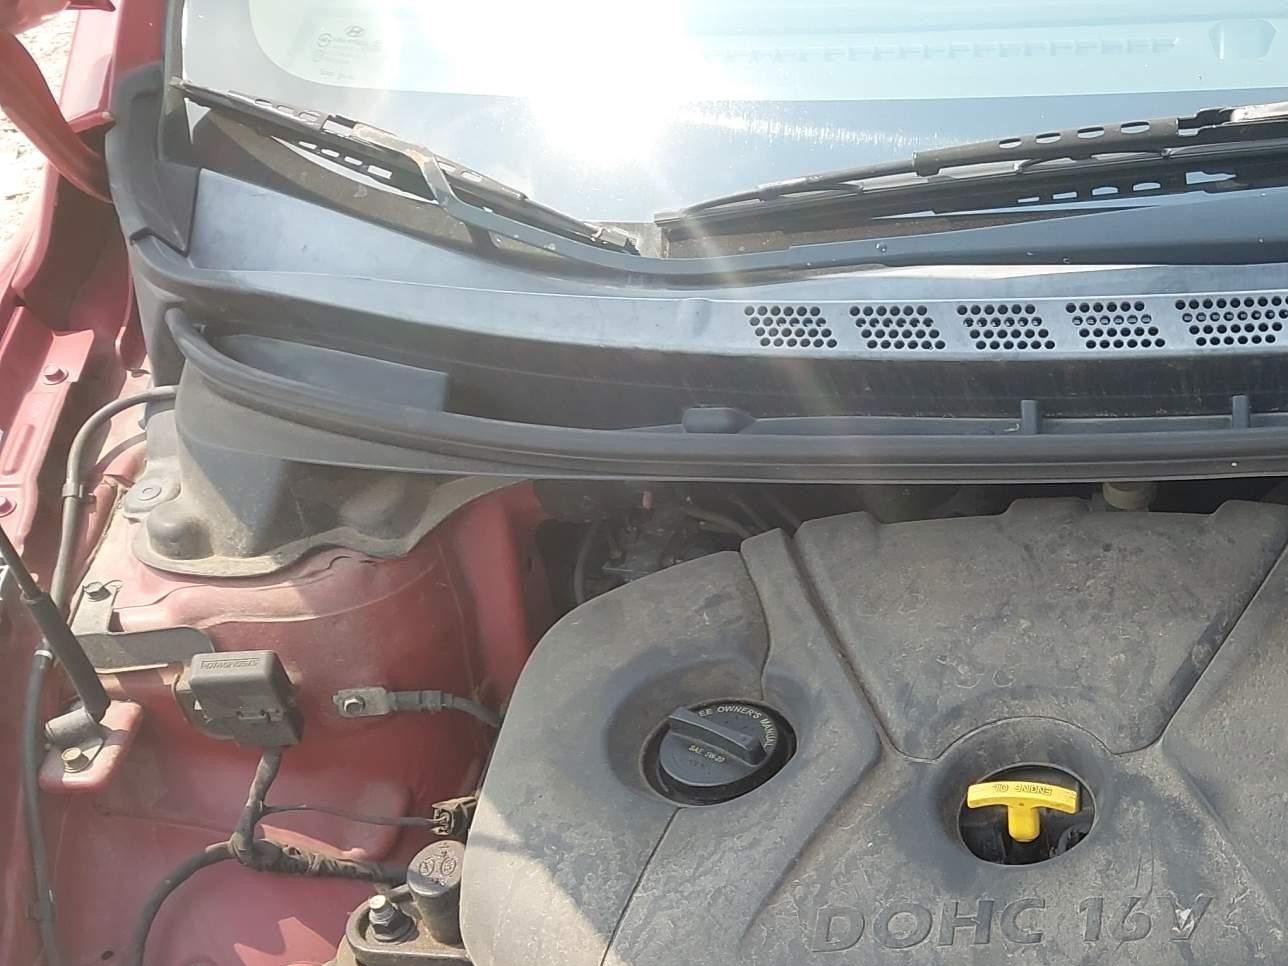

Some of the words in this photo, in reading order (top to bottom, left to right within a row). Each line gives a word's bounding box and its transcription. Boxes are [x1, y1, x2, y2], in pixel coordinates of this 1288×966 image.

[716, 705, 762, 719] OWNER'S
[760, 718, 777, 748] MANUAL
[812, 898, 1046, 953] DOHC
[1079, 895, 1213, 944] 16V
